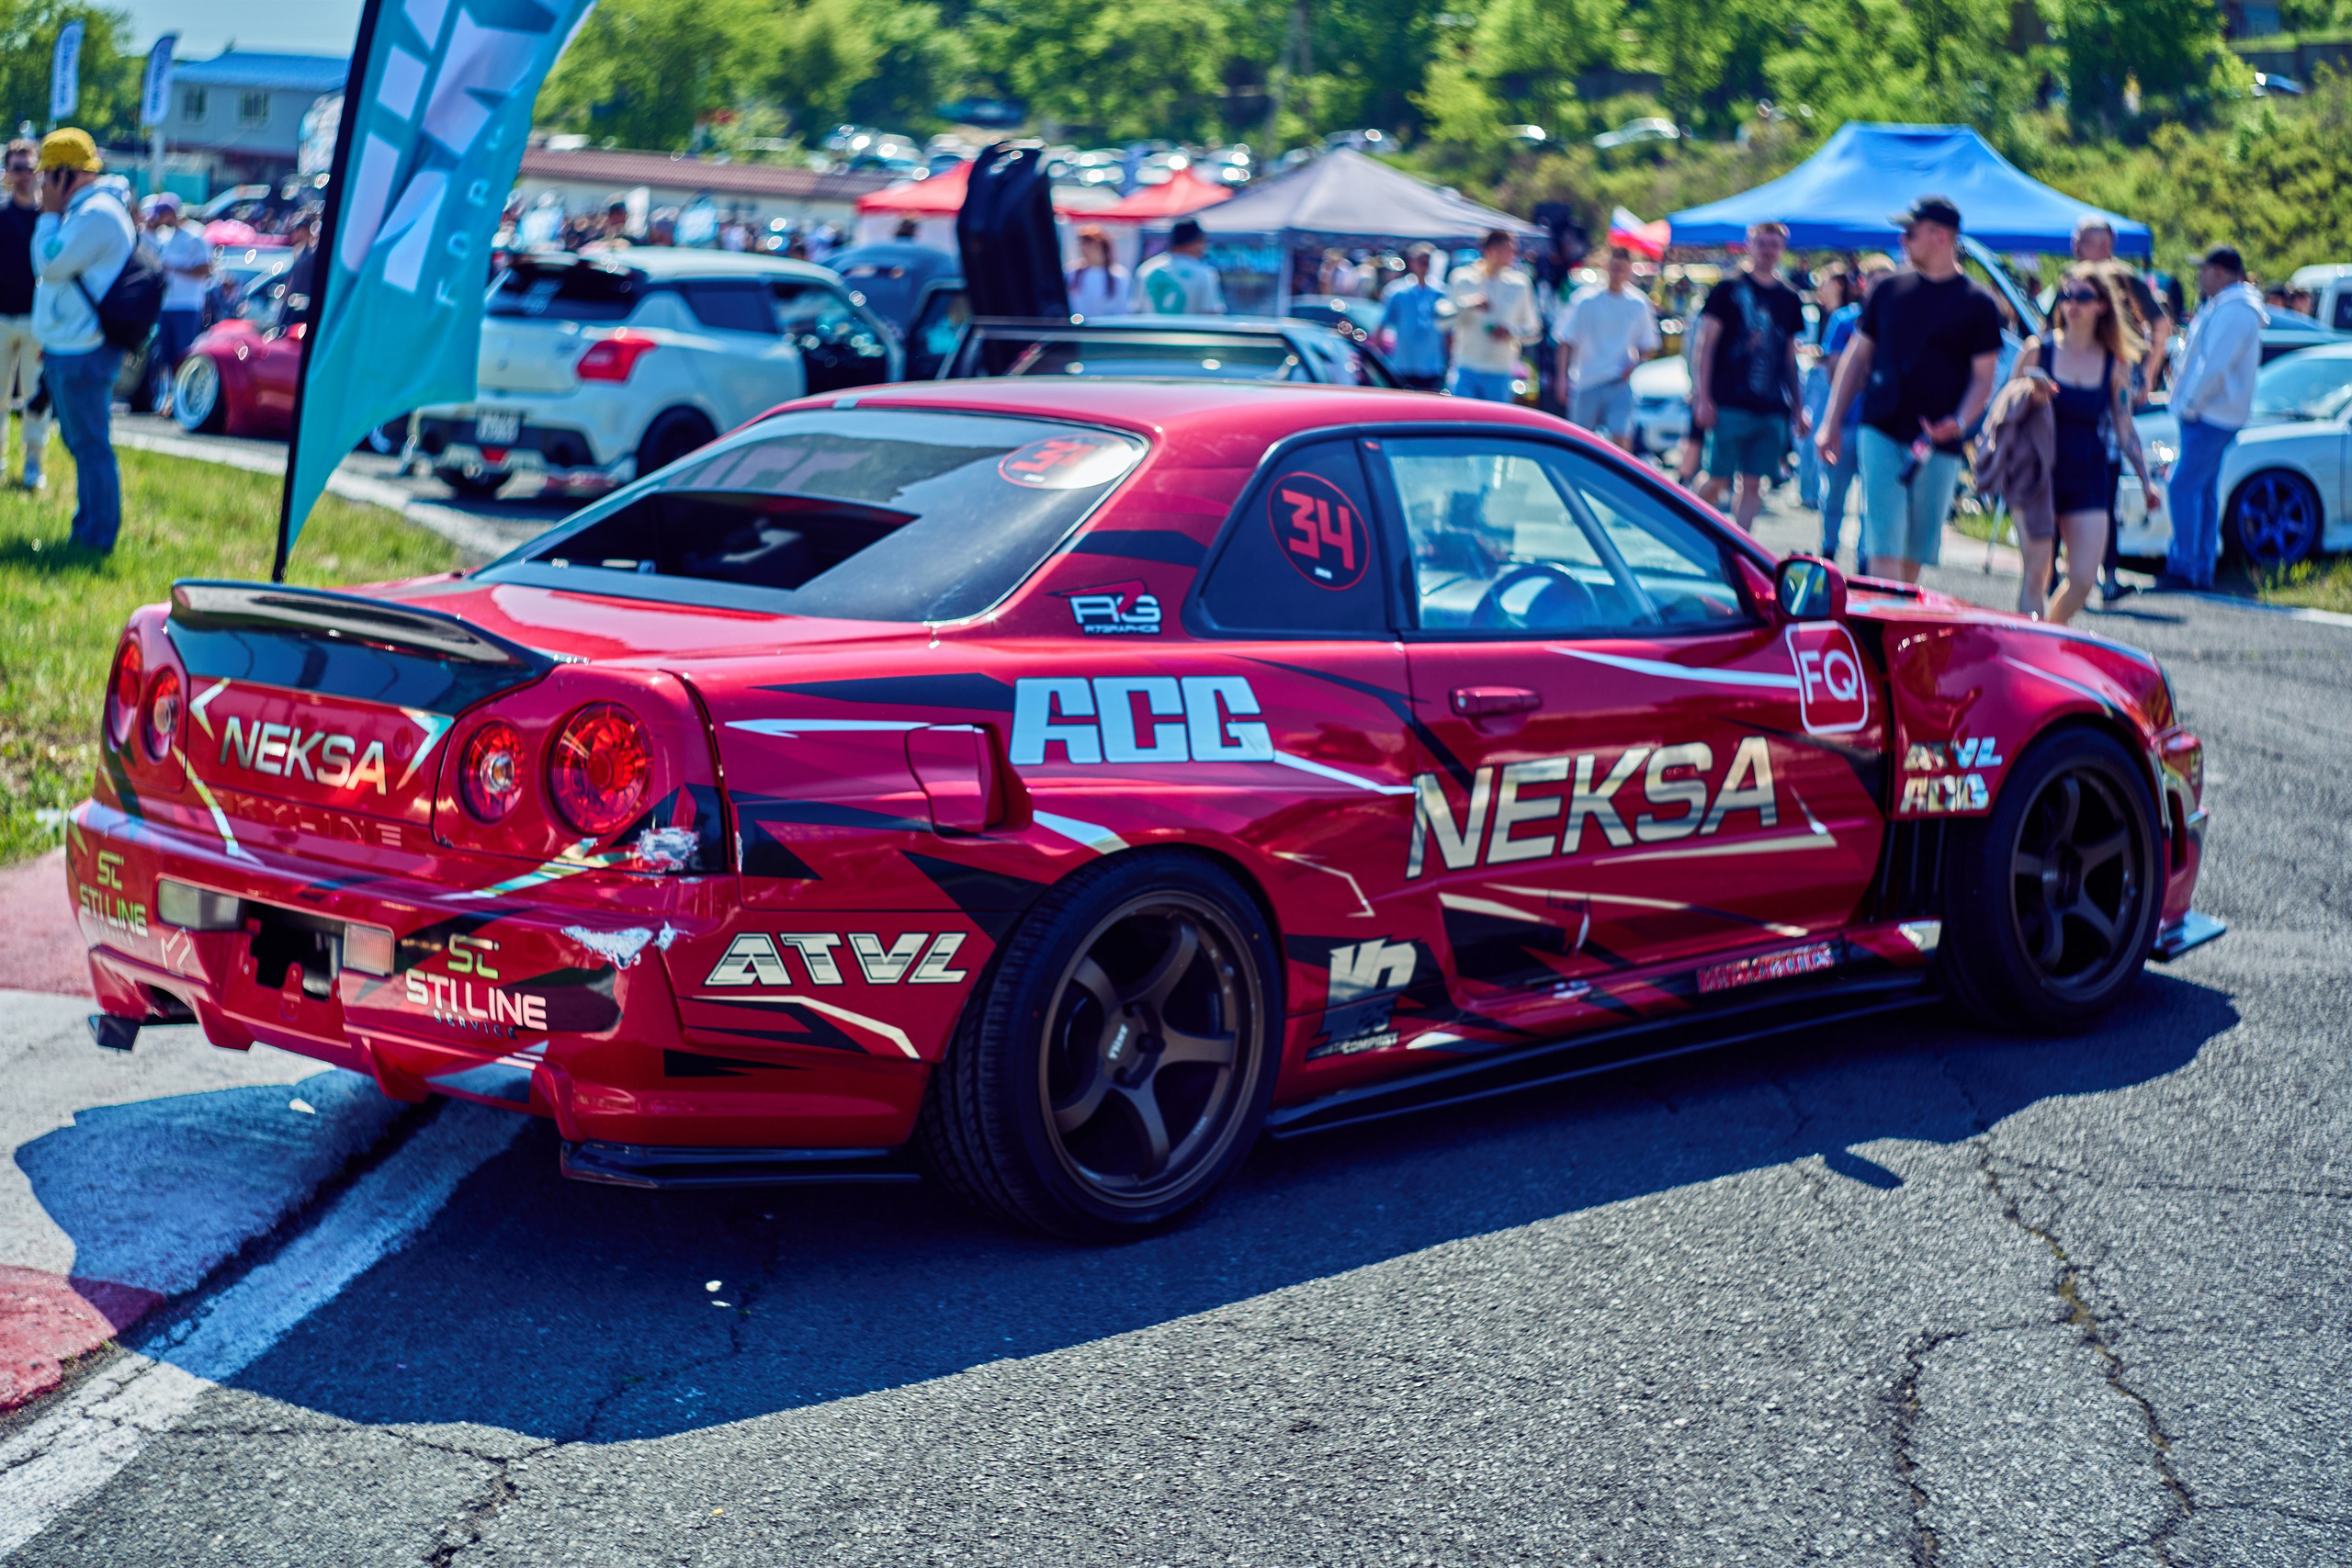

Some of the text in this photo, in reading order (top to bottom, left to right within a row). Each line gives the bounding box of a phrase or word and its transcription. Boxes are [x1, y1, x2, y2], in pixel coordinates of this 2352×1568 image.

[1281, 488, 1355, 571] 34
[1798, 649, 1858, 705] FQ
[219, 716, 388, 796] NEKSA
[1008, 676, 1275, 765] ACG
[1406, 735, 1779, 881] NEKSA
[701, 932, 968, 986] ATVL
[433, 1008, 517, 1040] SERVICE
